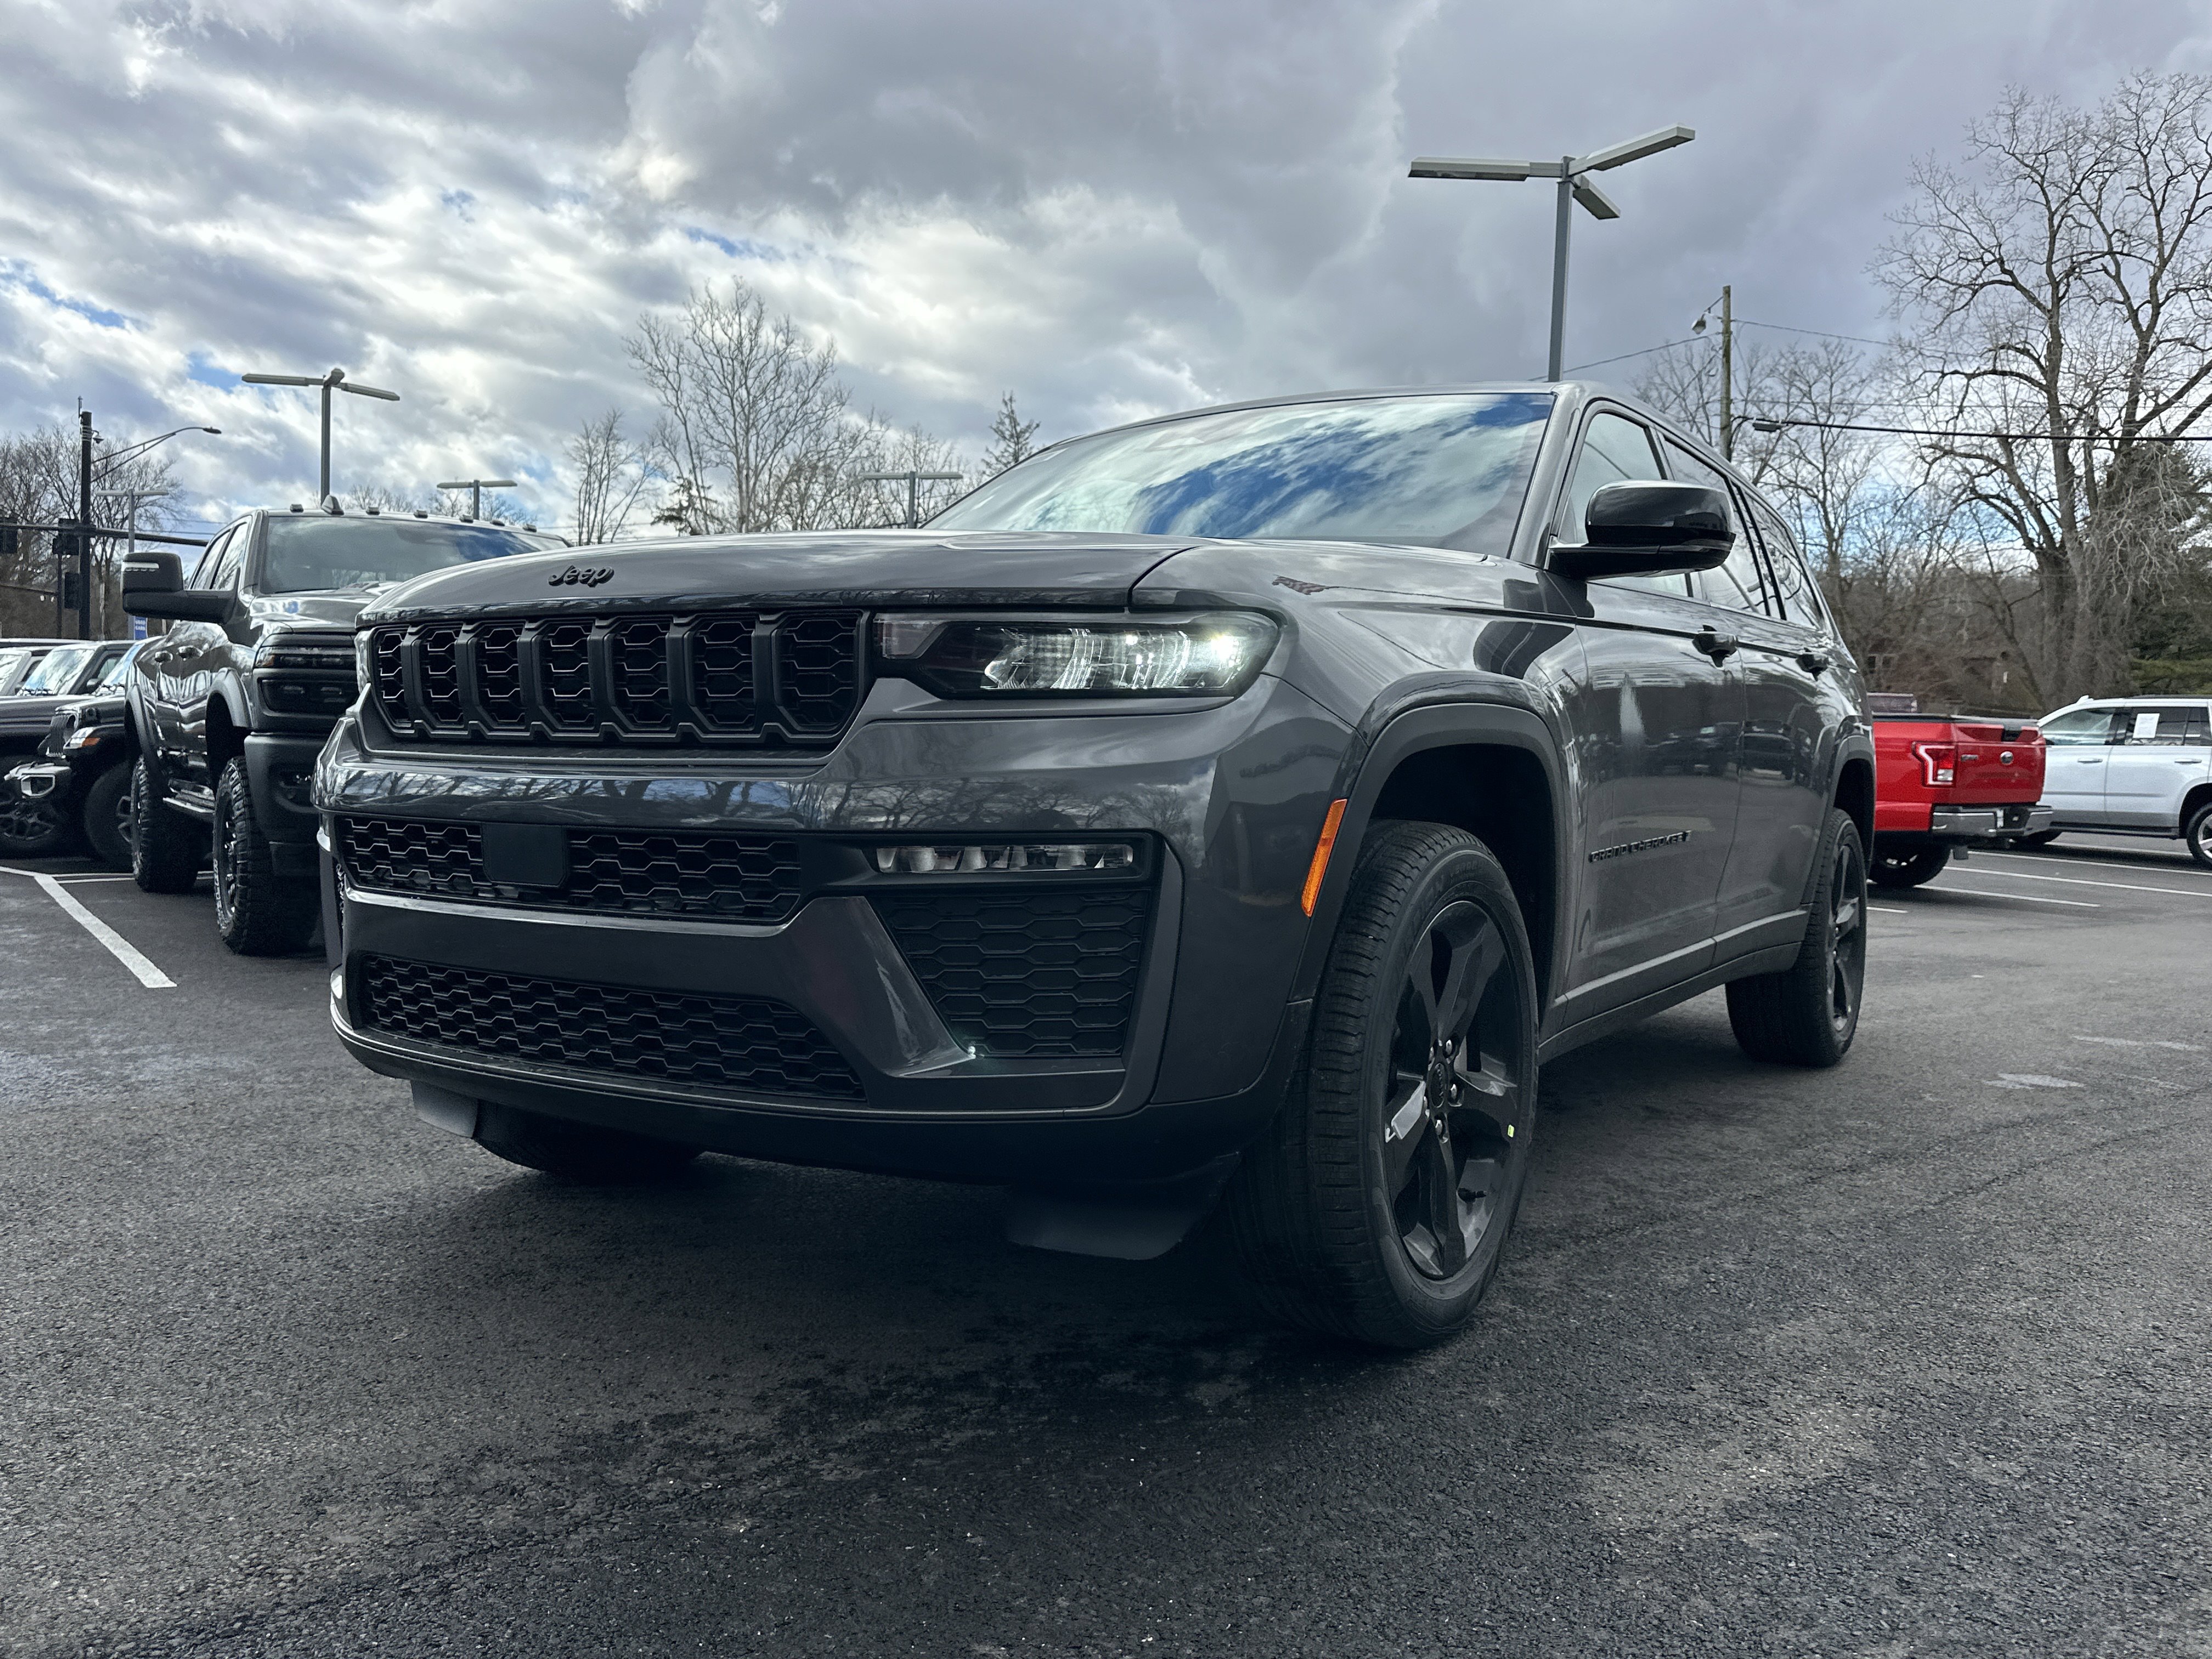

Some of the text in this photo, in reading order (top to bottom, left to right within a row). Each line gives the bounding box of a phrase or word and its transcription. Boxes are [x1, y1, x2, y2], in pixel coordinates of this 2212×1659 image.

[548, 565, 614, 588] Jeep
[1588, 844, 1627, 863] GRAND
[1628, 832, 1683, 854] CHEROKEE
